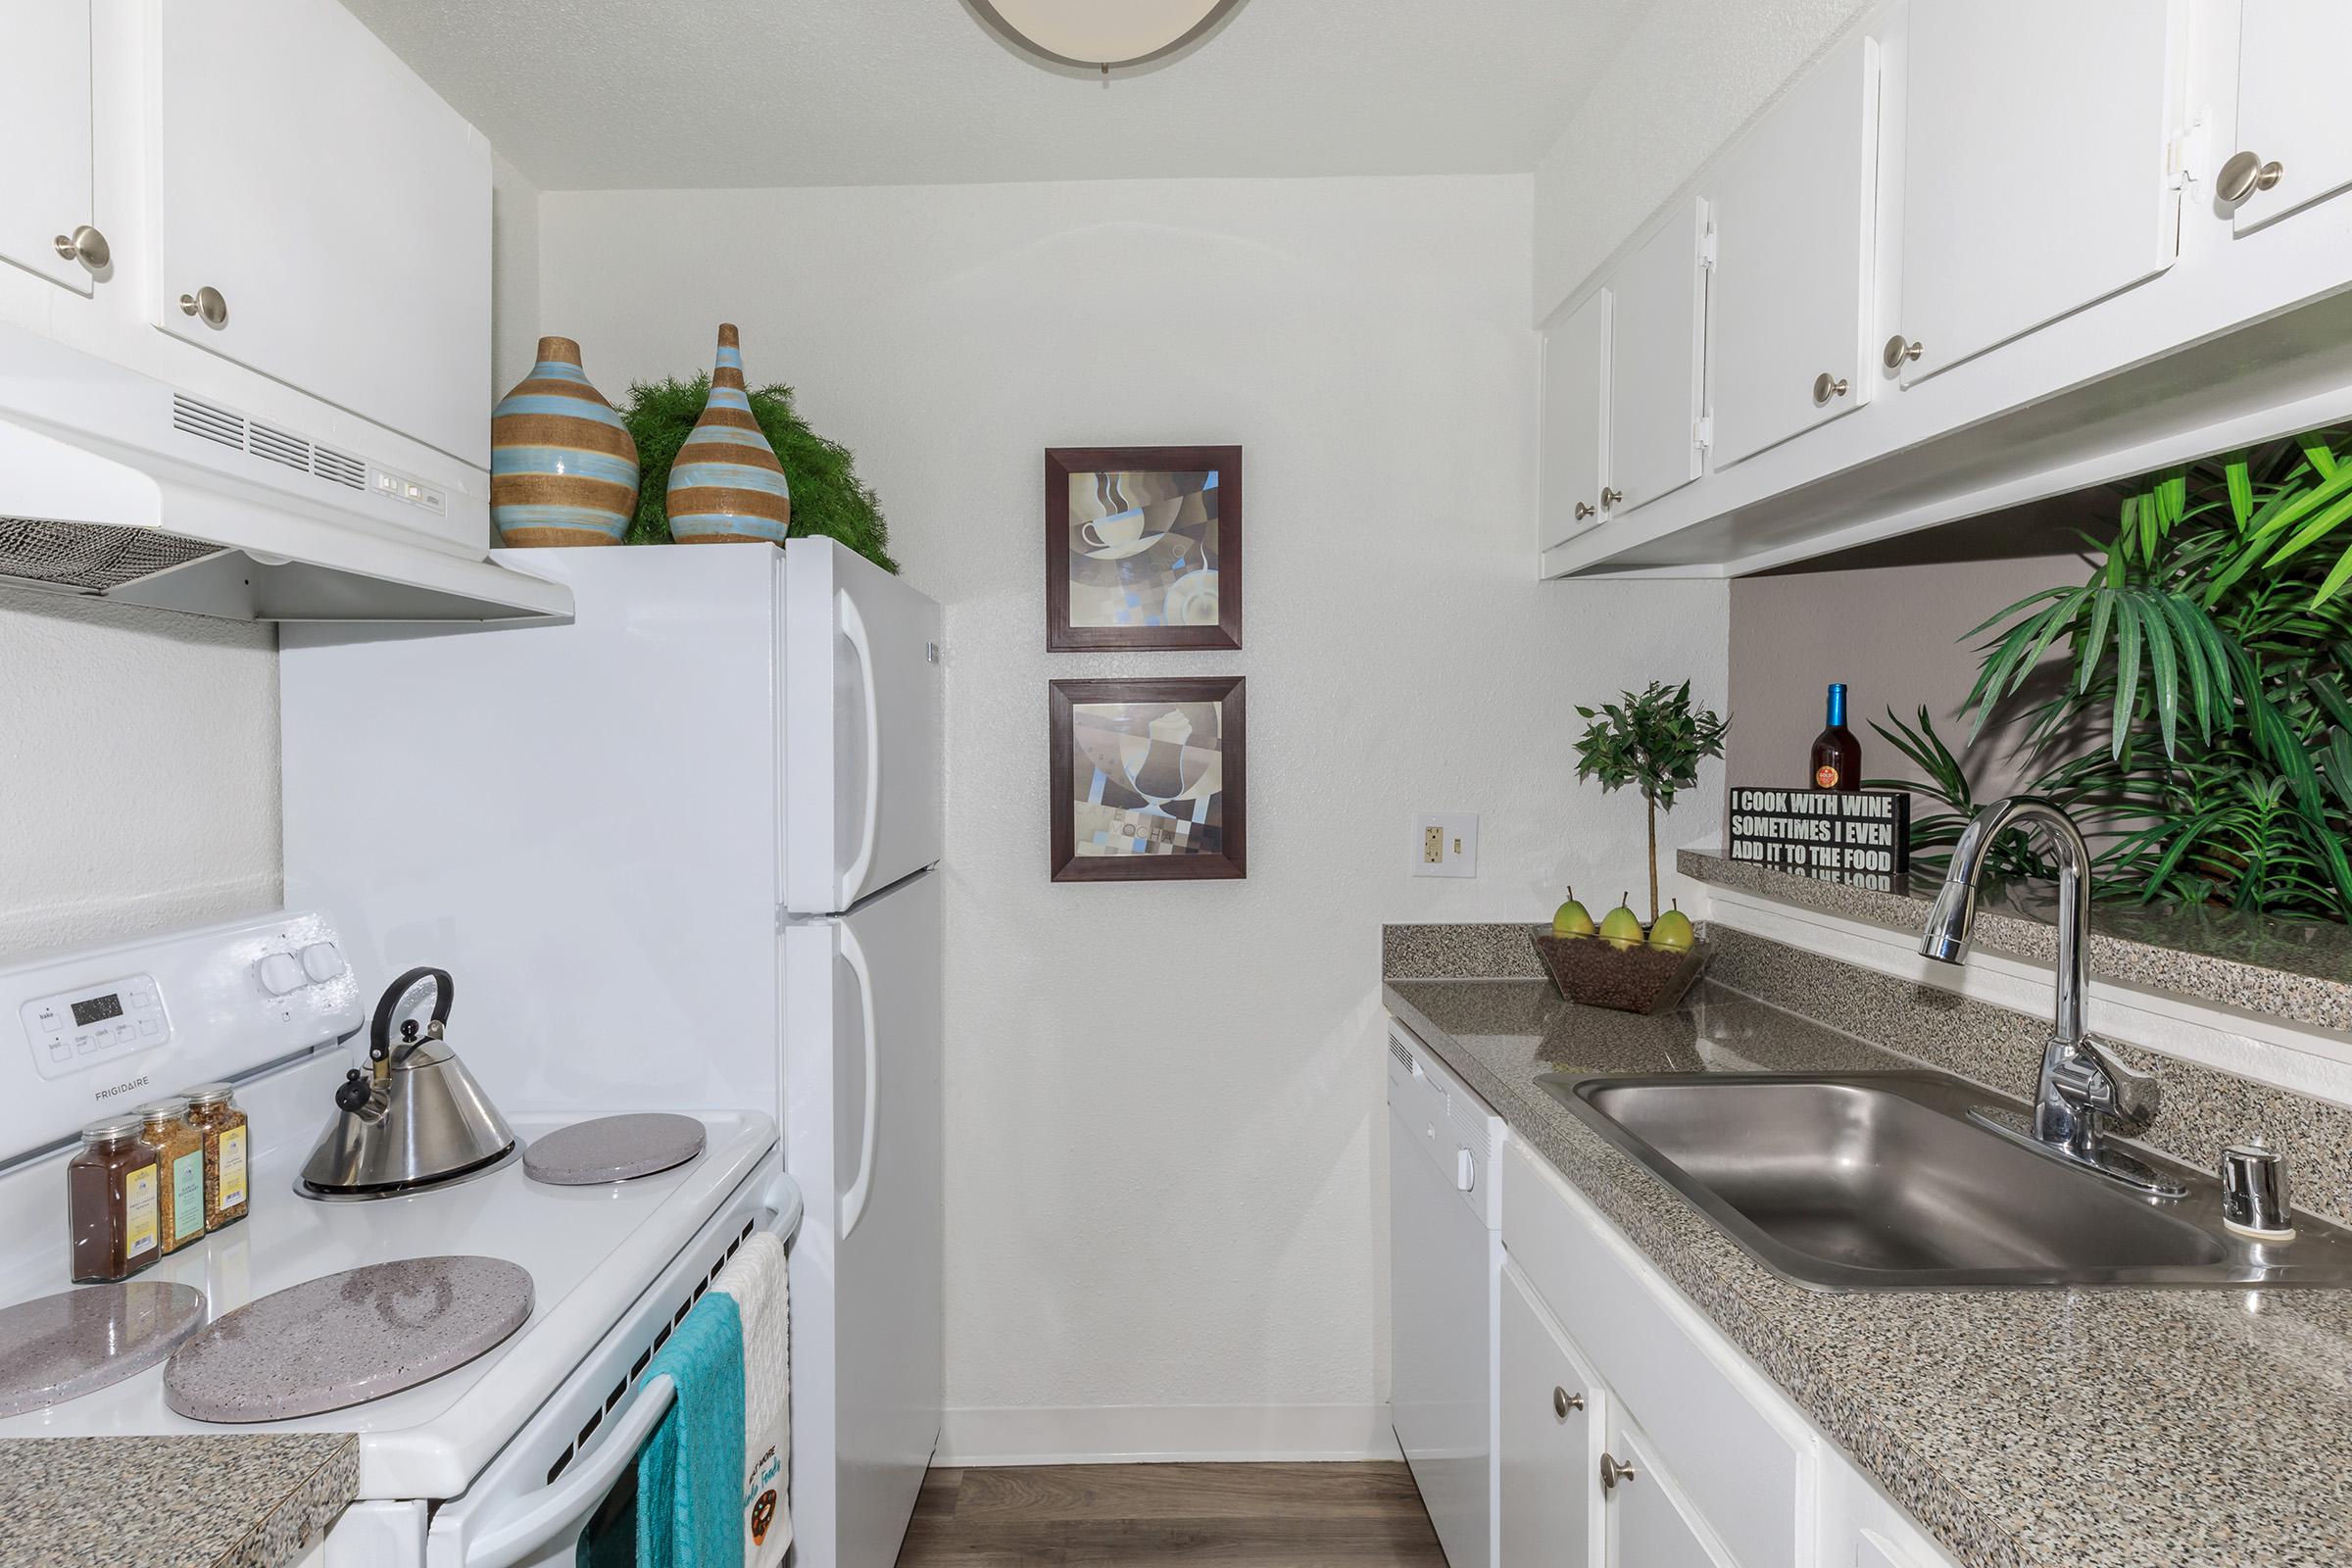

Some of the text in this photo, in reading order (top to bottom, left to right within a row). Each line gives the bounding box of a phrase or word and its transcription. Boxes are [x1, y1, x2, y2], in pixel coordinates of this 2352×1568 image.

[1732, 790, 1892, 818] I COOK WITH WINE
[1732, 814, 1892, 847] SOMETIMES I EVEN
[1732, 840, 1891, 872] ADD IT TO THE FOOD
[95, 1075, 149, 1102] FRIGIDAIRE
